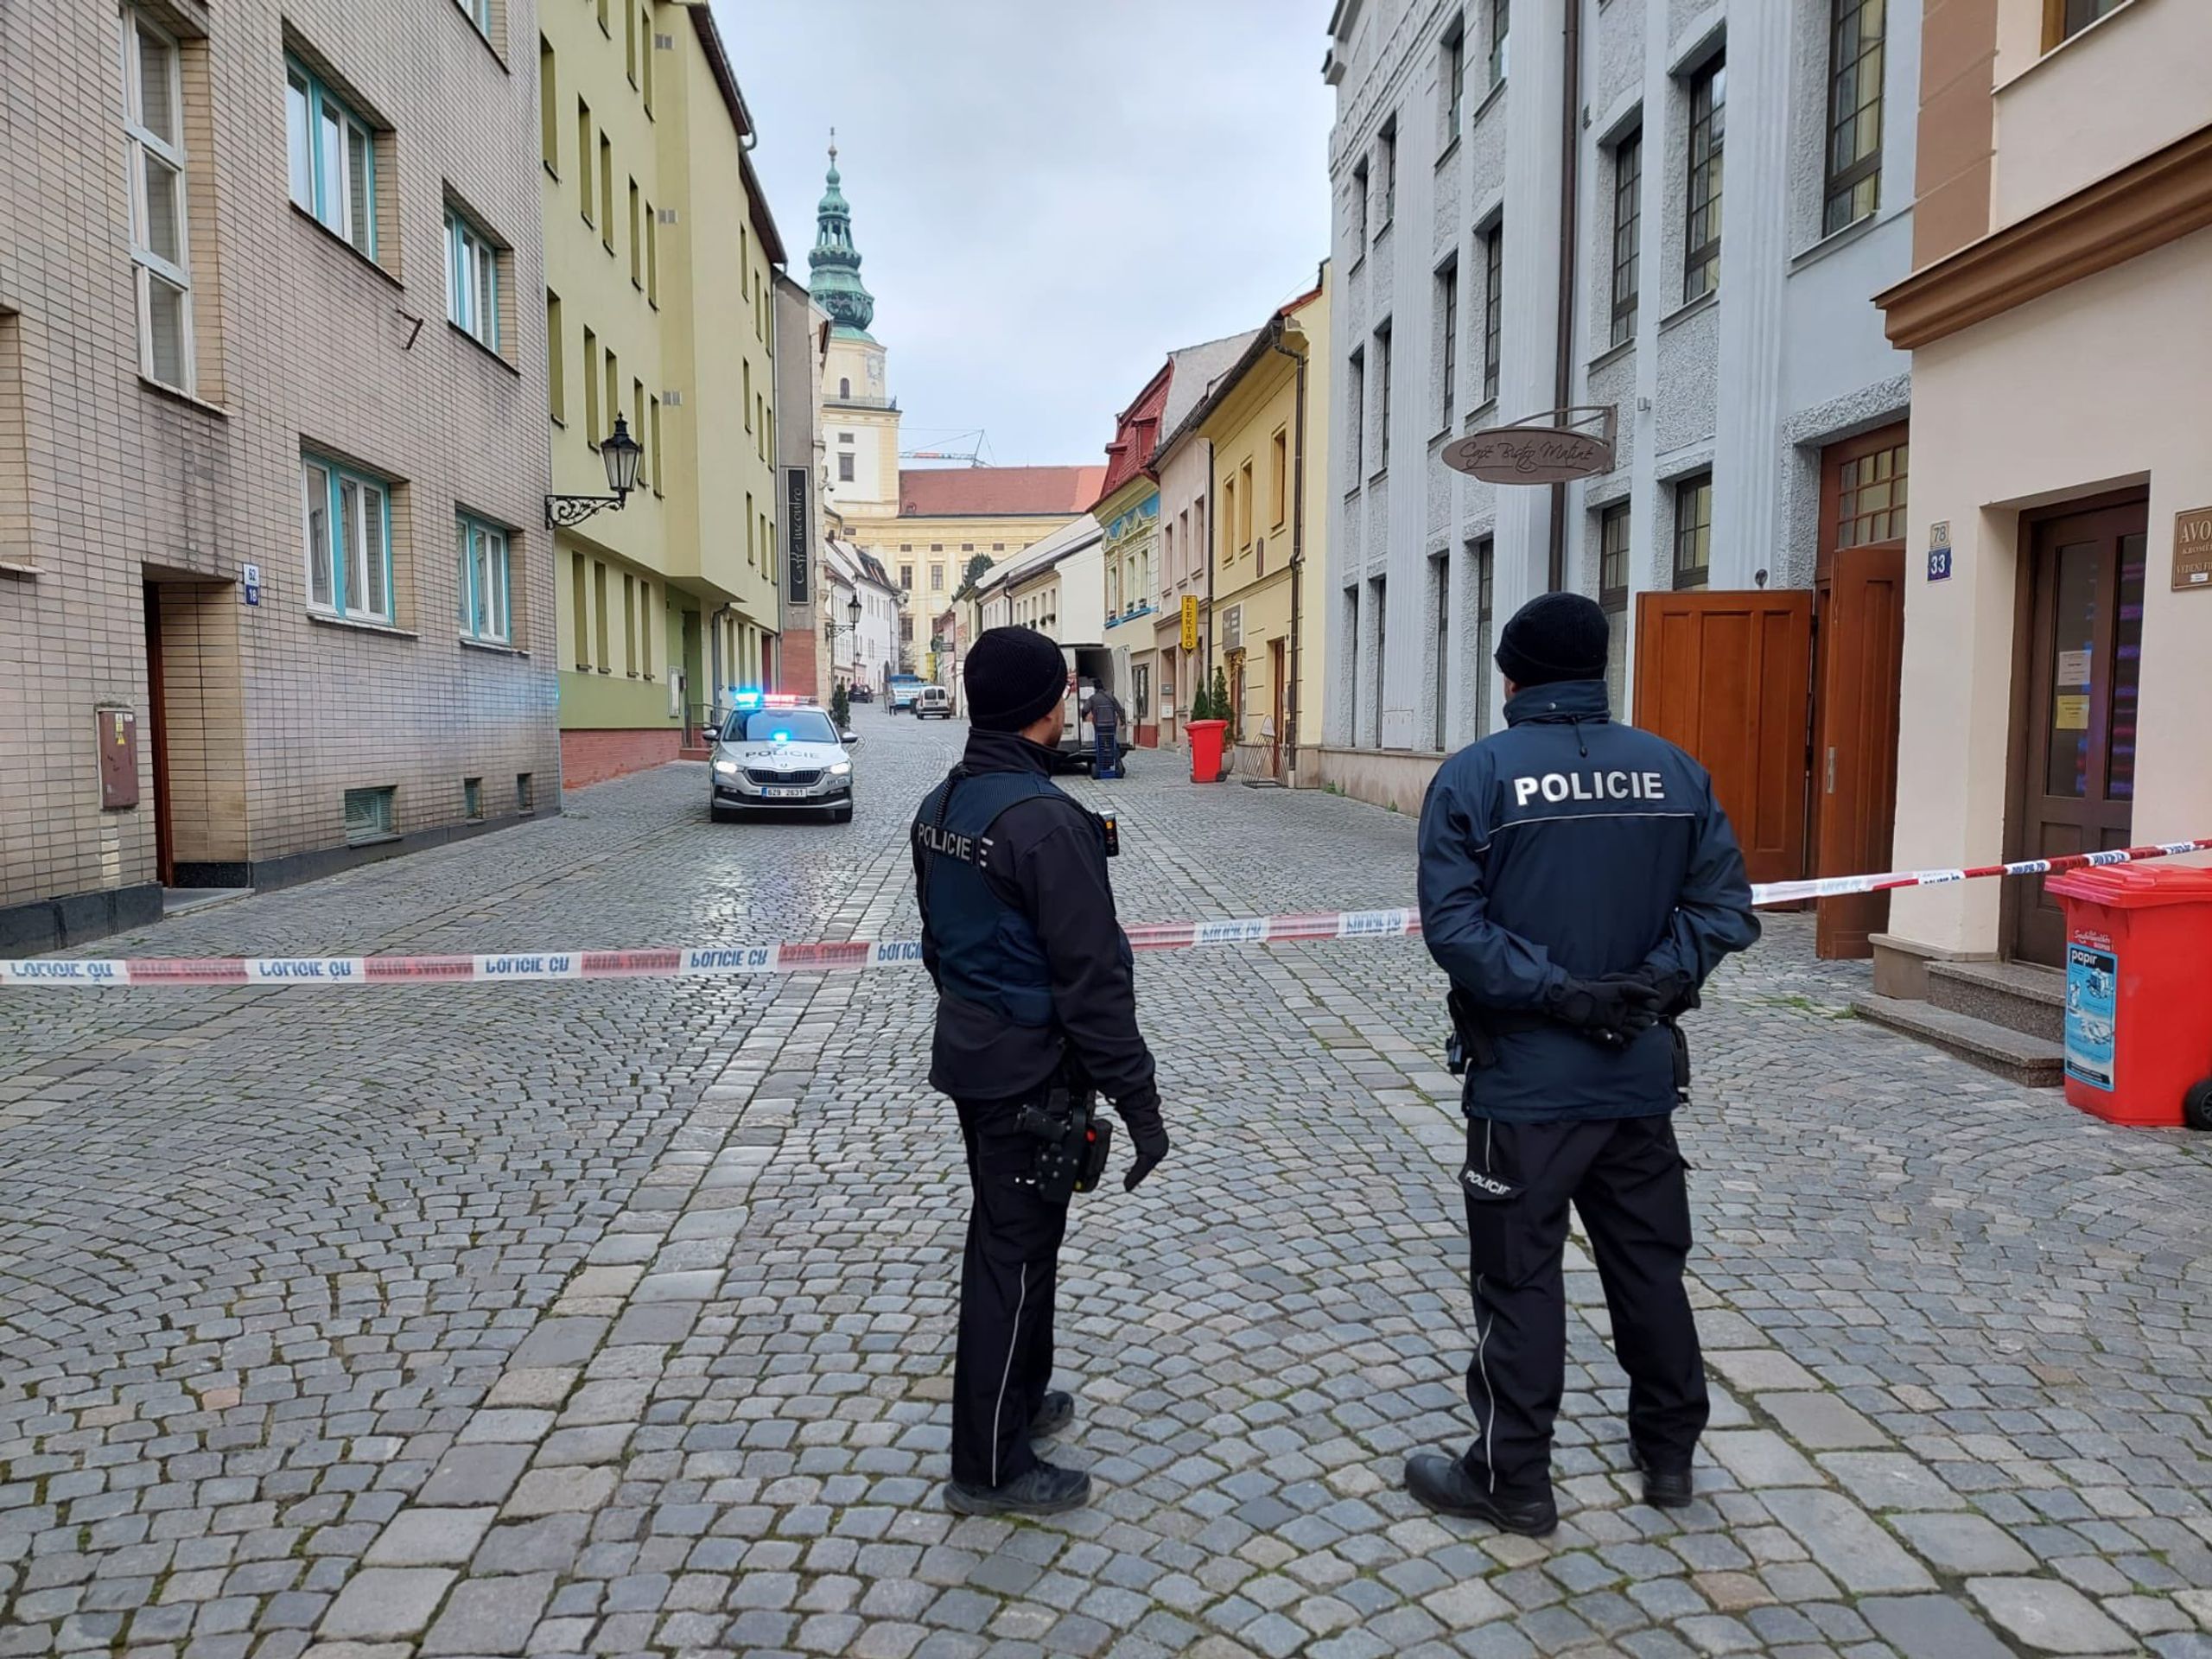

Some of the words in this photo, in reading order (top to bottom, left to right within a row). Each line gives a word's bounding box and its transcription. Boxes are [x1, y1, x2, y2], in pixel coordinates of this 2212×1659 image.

[1933, 524, 1947, 543] 78
[2179, 519, 2212, 544] AVO
[1929, 553, 1946, 575] 33
[249, 588, 257, 603] 18
[745, 749, 821, 760] POLICIE
[1514, 771, 1666, 806] POLICIE
[918, 822, 972, 861] POLICIE
